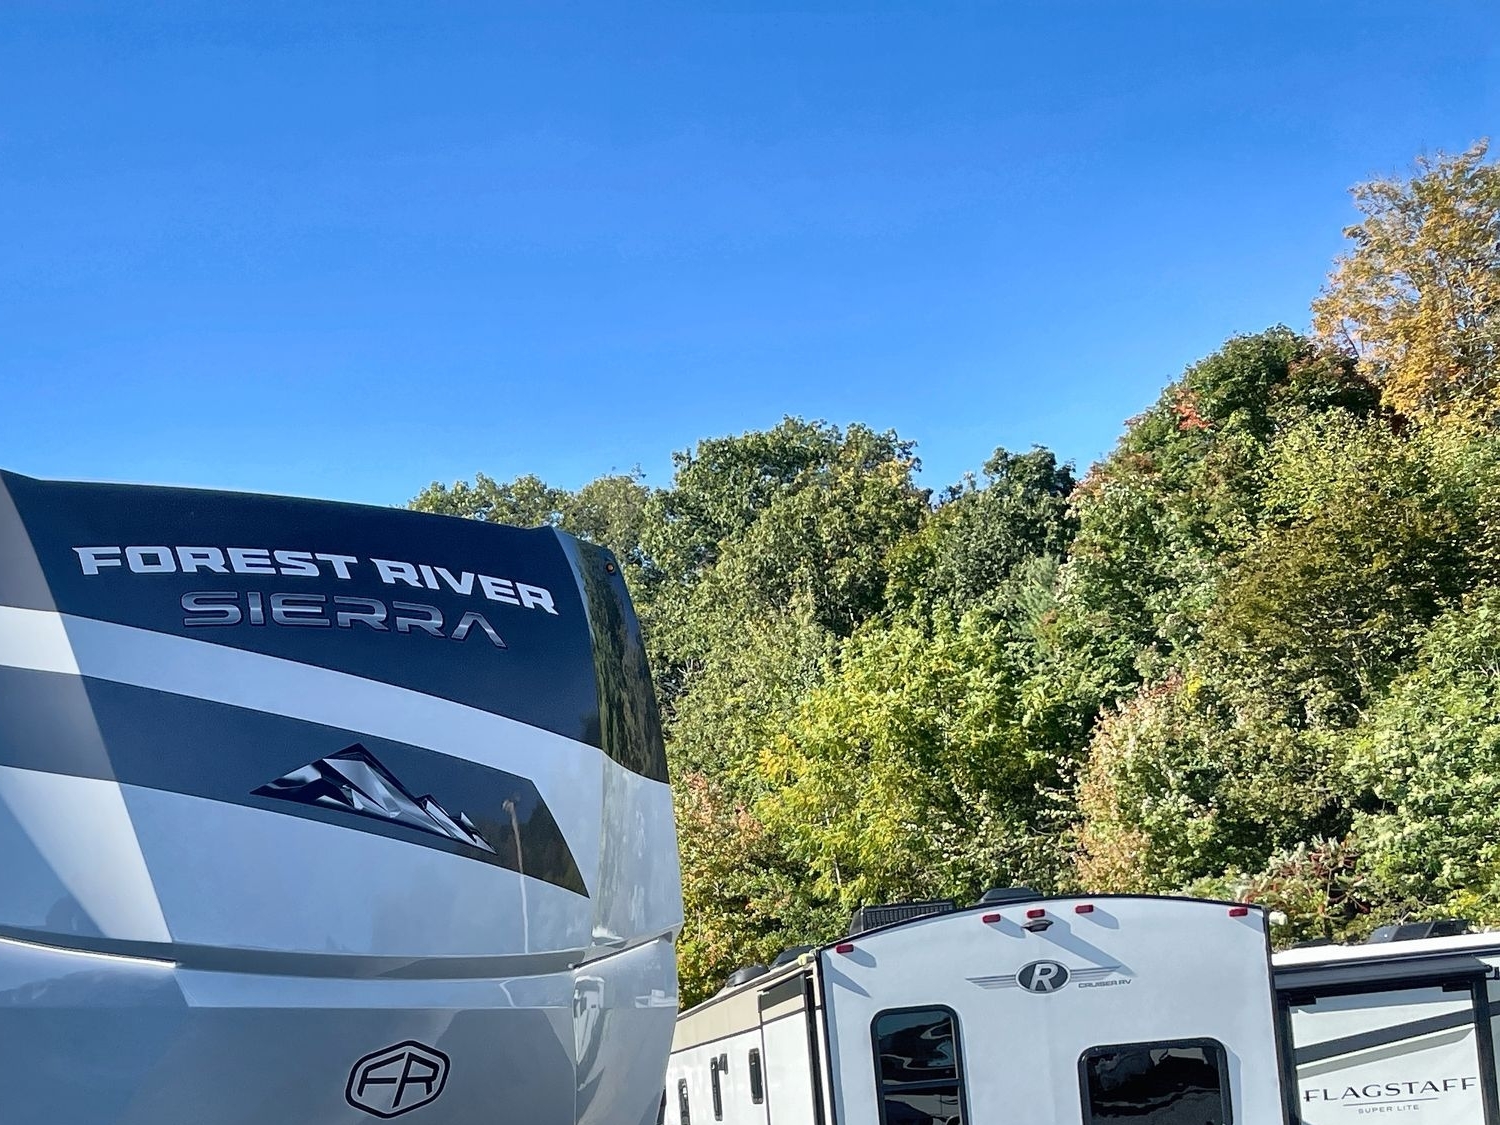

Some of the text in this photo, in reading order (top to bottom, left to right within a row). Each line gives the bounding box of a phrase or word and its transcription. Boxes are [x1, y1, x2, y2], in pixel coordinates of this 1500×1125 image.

[72, 546, 560, 616] FOREST RIVER
[180, 590, 508, 650] SIERRA
[1029, 963, 1059, 992] R
[1078, 980, 1118, 989] CRUISER
[357, 1051, 440, 1109] FR
[1303, 1076, 1477, 1102] FLAGSTAFF
[1358, 1106, 1393, 1114] SUPER
